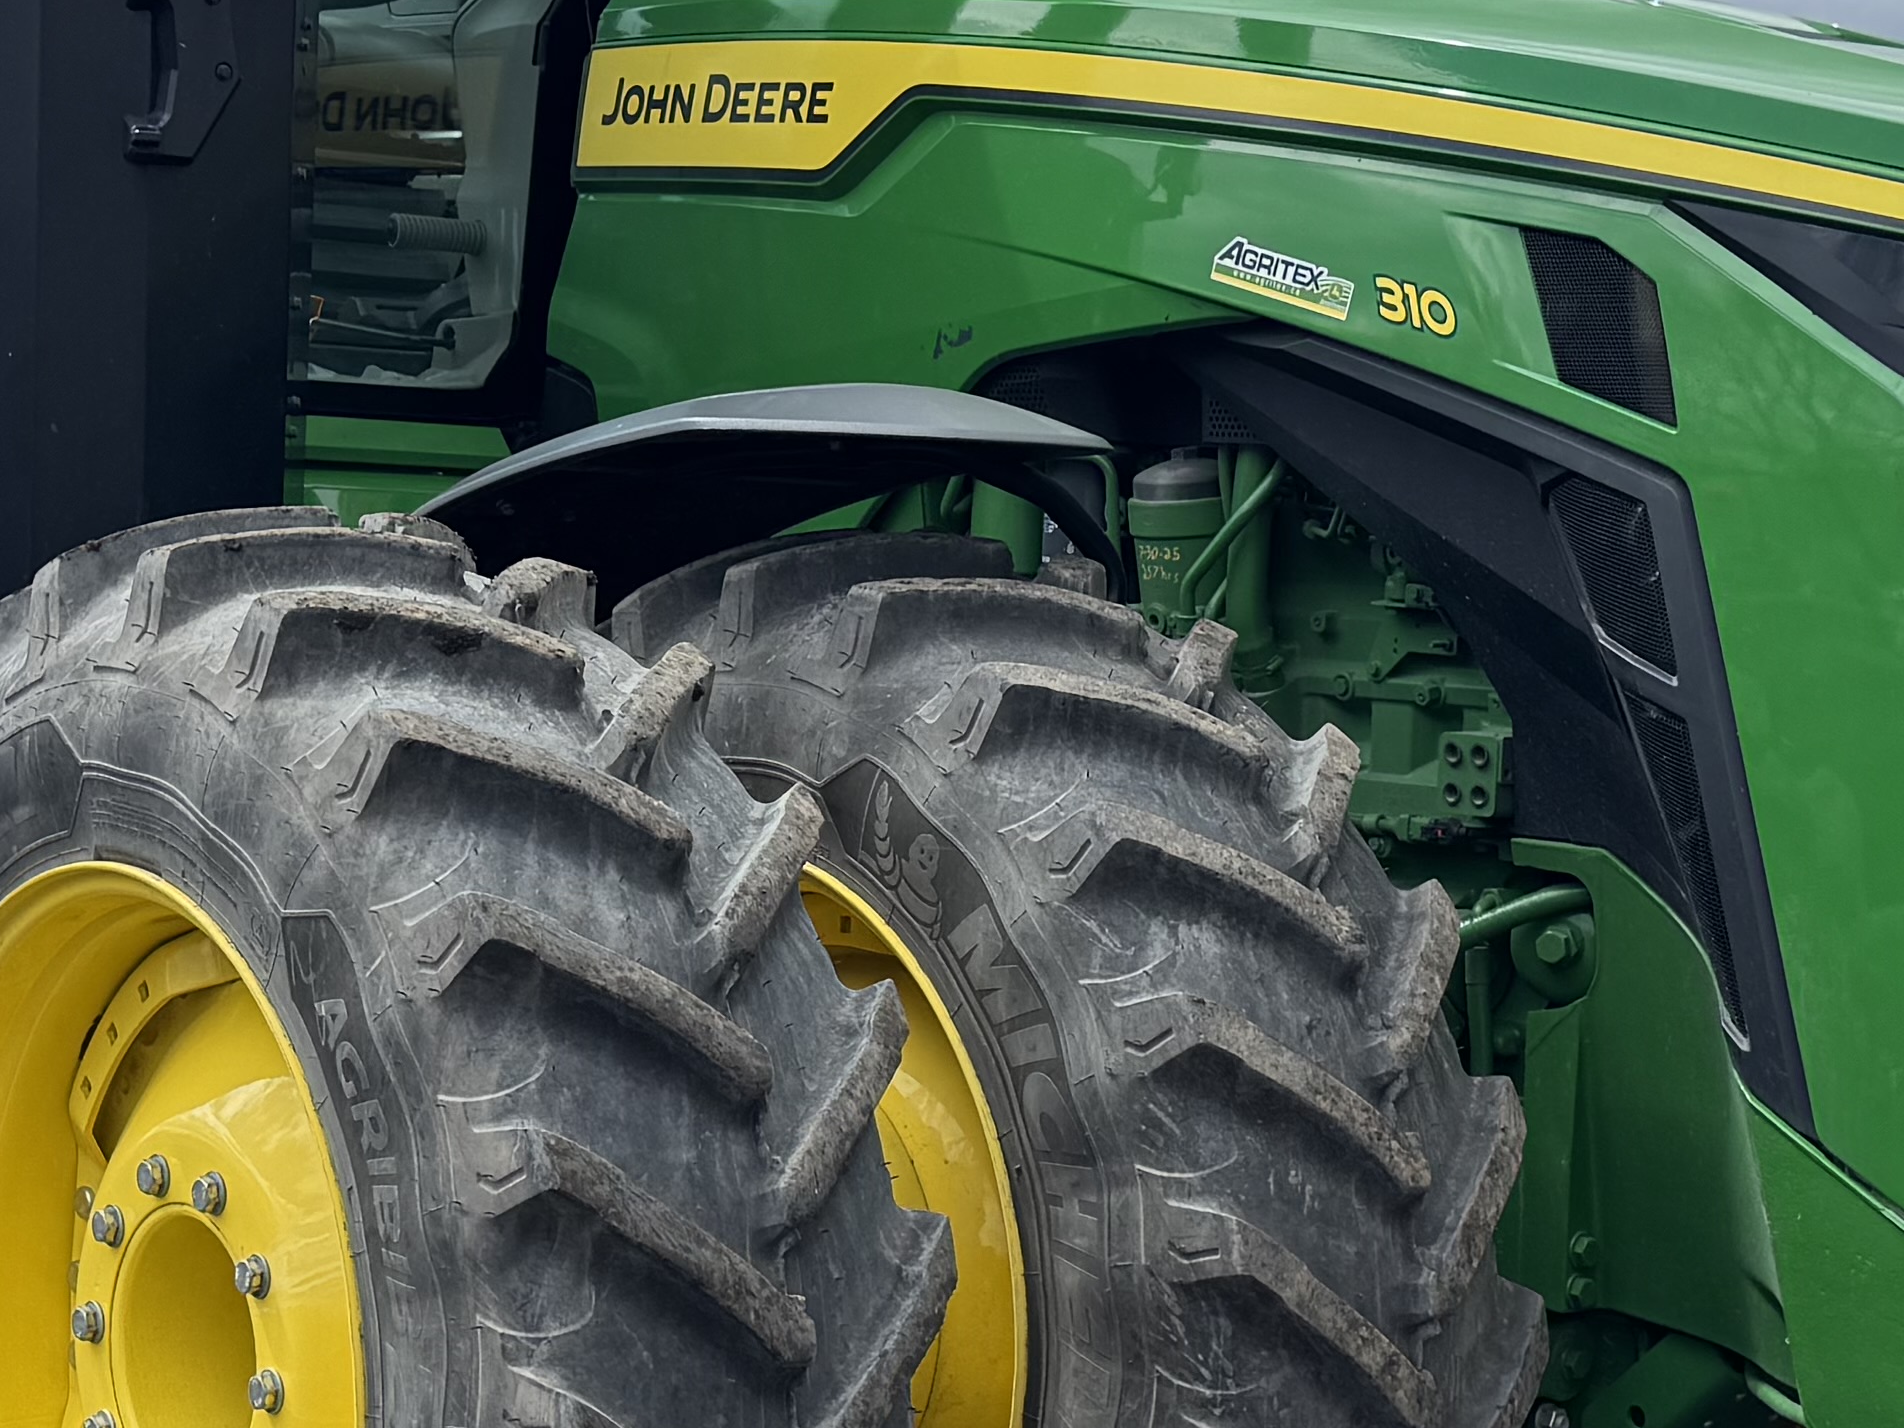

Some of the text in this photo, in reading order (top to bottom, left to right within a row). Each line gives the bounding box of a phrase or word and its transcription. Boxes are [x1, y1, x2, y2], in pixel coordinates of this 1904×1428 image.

[601, 73, 834, 125] JOHN DEERE
[1218, 240, 1327, 291] AGRITEX
[1374, 274, 1457, 337] 310
